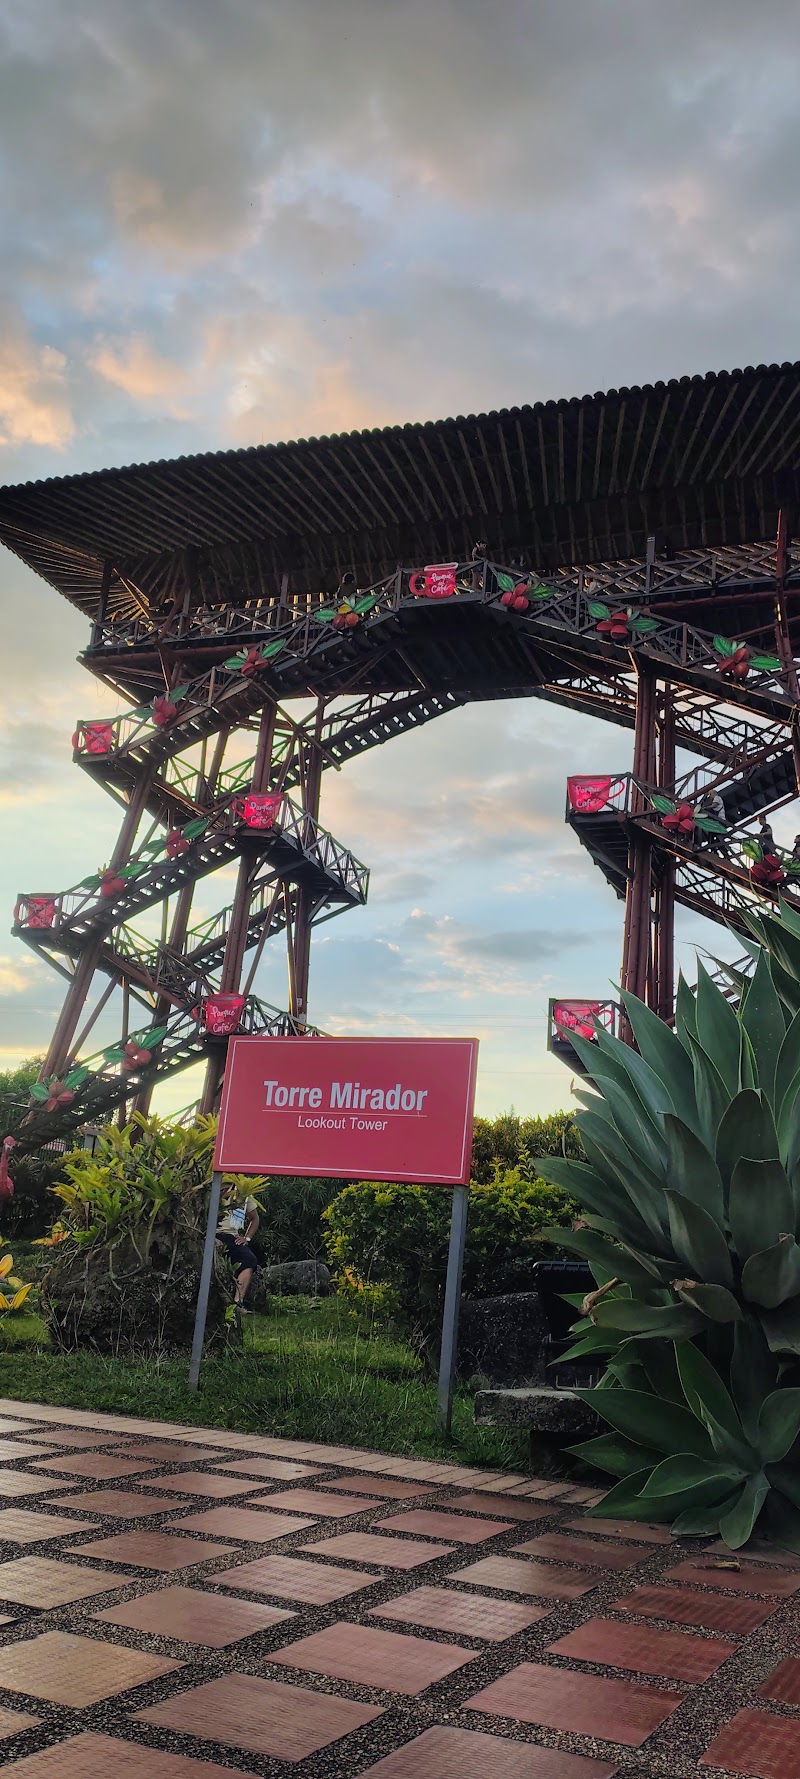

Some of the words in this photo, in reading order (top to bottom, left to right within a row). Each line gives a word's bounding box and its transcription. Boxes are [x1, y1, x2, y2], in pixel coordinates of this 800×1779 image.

[263, 1080, 323, 1108] Torre
[329, 1082, 429, 1111] Mirador
[297, 1115, 347, 1130] Lookout
[349, 1117, 388, 1131] Tower
